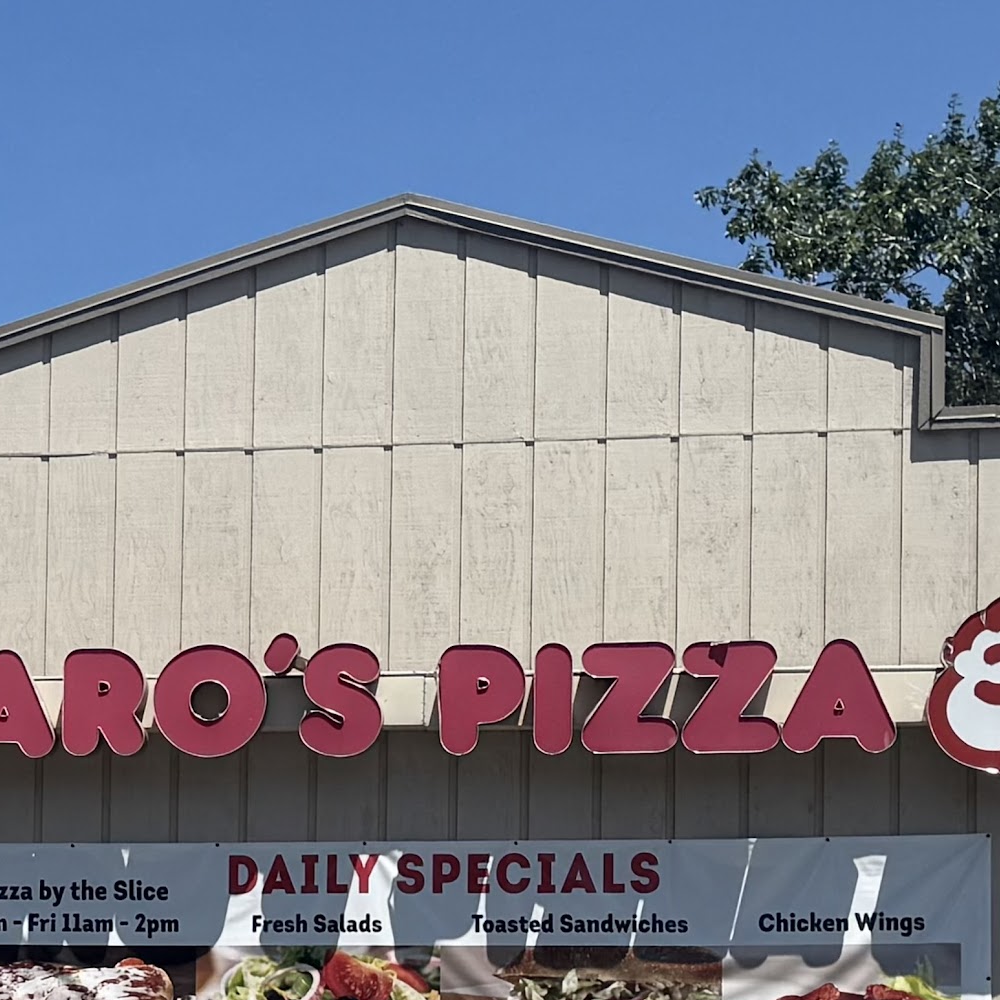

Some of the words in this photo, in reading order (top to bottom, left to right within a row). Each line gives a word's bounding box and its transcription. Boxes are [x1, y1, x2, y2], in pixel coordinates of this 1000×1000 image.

[436, 639, 897, 755] PIZZA
[228, 853, 379, 895] DAILY
[396, 852, 661, 895] SPECIALS
[39, 880, 65, 906] by
[69, 880, 108, 901] the
[112, 879, 169, 901] Slice
[27, 913, 57, 933] Fri
[62, 913, 114, 933] 11am
[134, 913, 180, 939] 2pm
[252, 914, 308, 933] Fresh
[313, 914, 383, 933] Salads
[472, 914, 554, 934] Toasted
[559, 914, 689, 934] Sandwiches
[758, 912, 849, 933] Chicken
[854, 912, 926, 937] Wings
